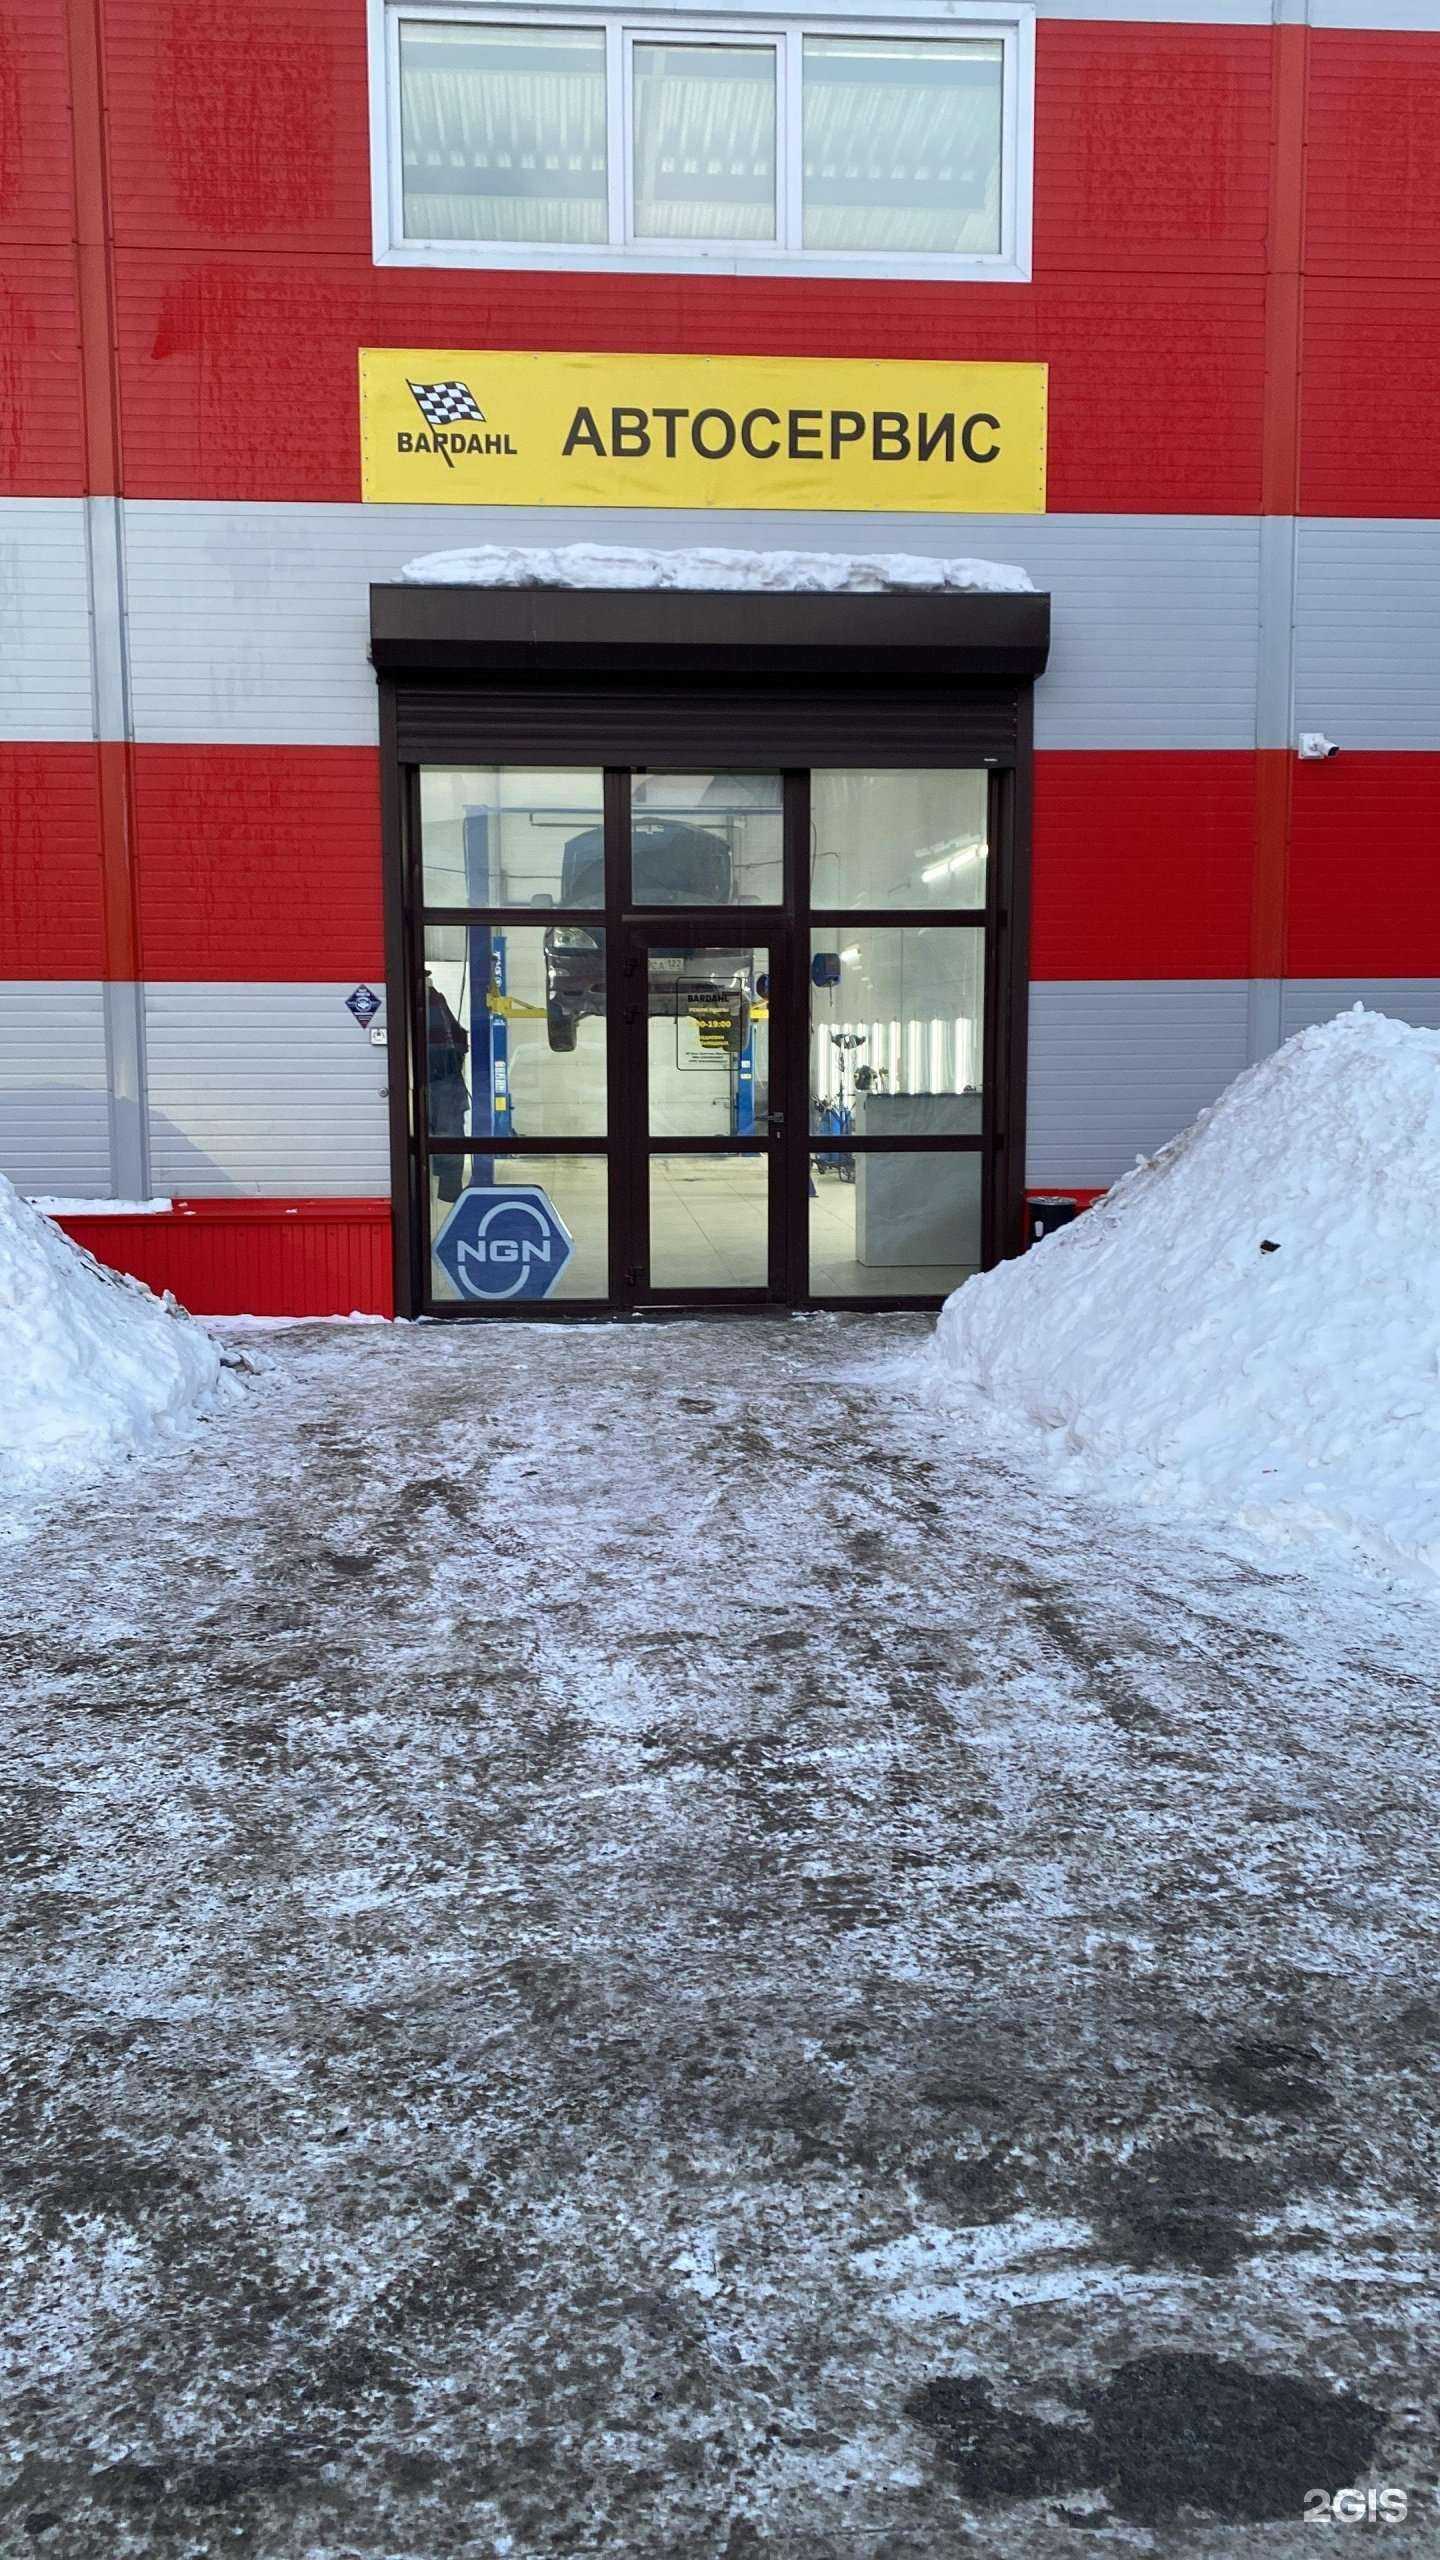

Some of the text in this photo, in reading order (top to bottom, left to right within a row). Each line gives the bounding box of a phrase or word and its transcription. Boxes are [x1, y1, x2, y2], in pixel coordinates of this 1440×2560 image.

[397, 432, 517, 456] BARDAHL
[562, 406, 1001, 463] АВТОСЕРВИС
[457, 1240, 550, 1262] NGN
